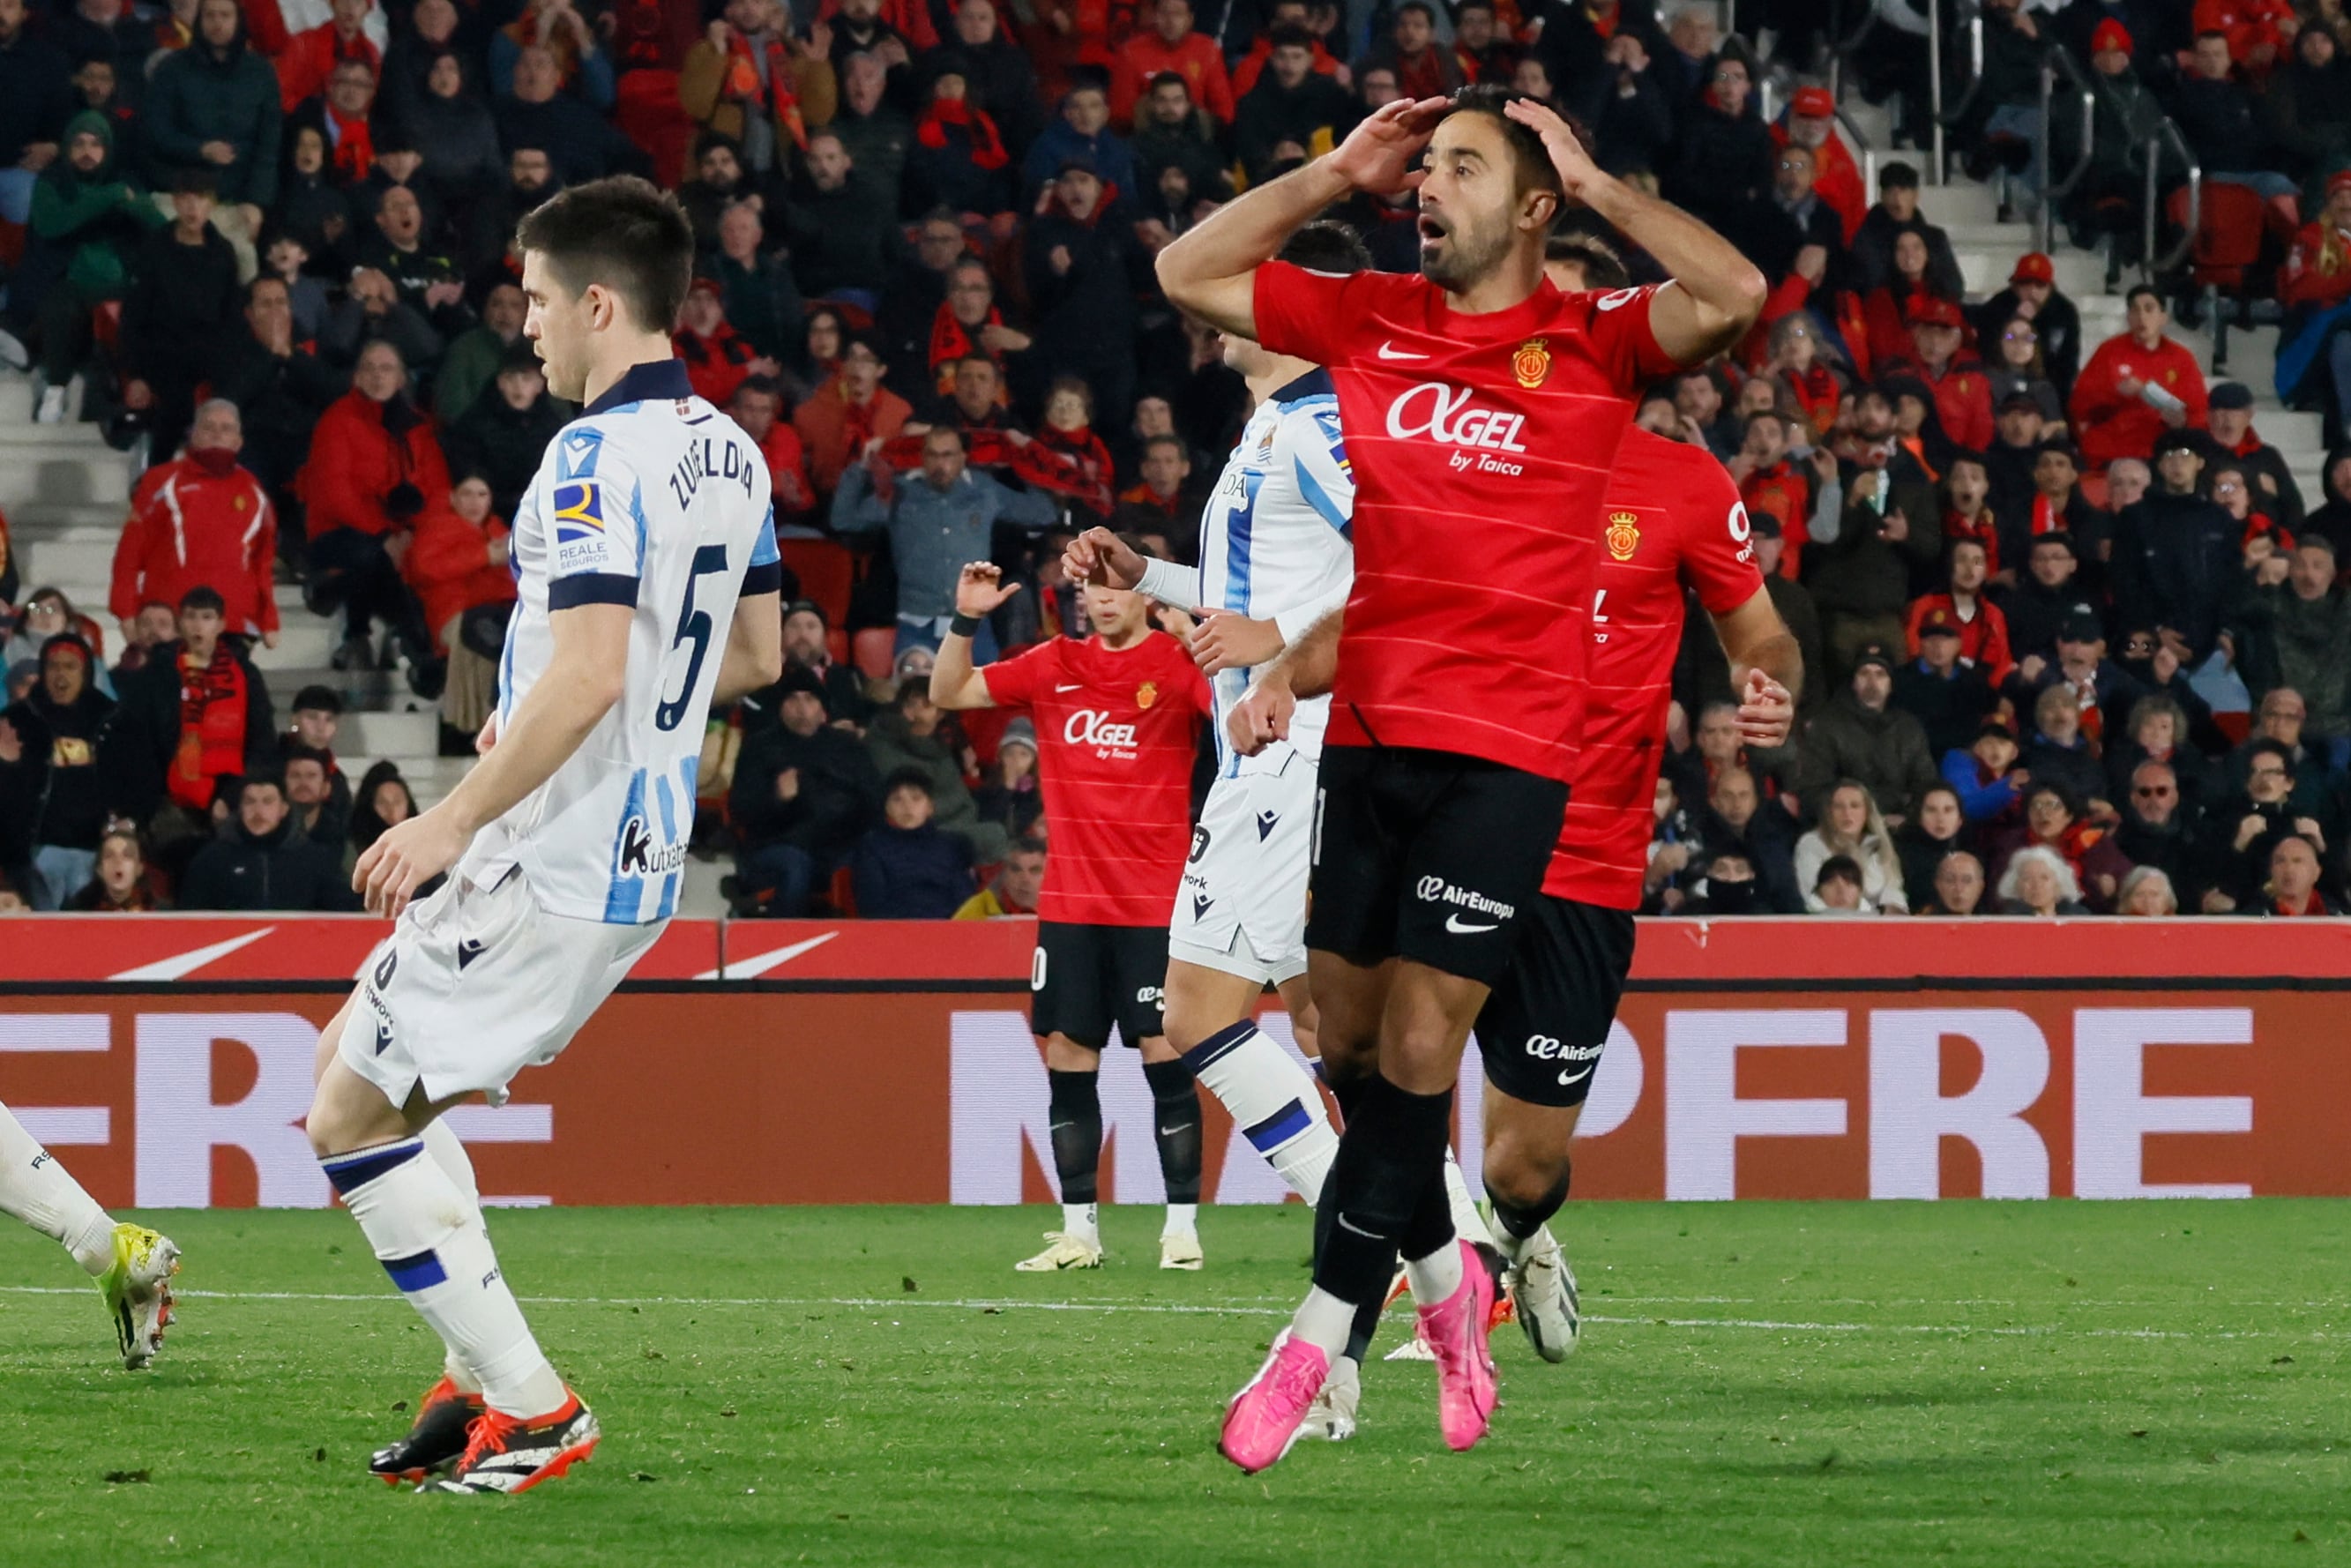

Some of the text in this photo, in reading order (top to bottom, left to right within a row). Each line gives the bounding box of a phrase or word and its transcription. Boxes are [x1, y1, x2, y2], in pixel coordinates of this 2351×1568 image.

[1449, 449, 1524, 476] by Taica
[559, 541, 608, 561] REALE
[560, 554, 609, 571] SEGUROS
[655, 544, 729, 732] 5
